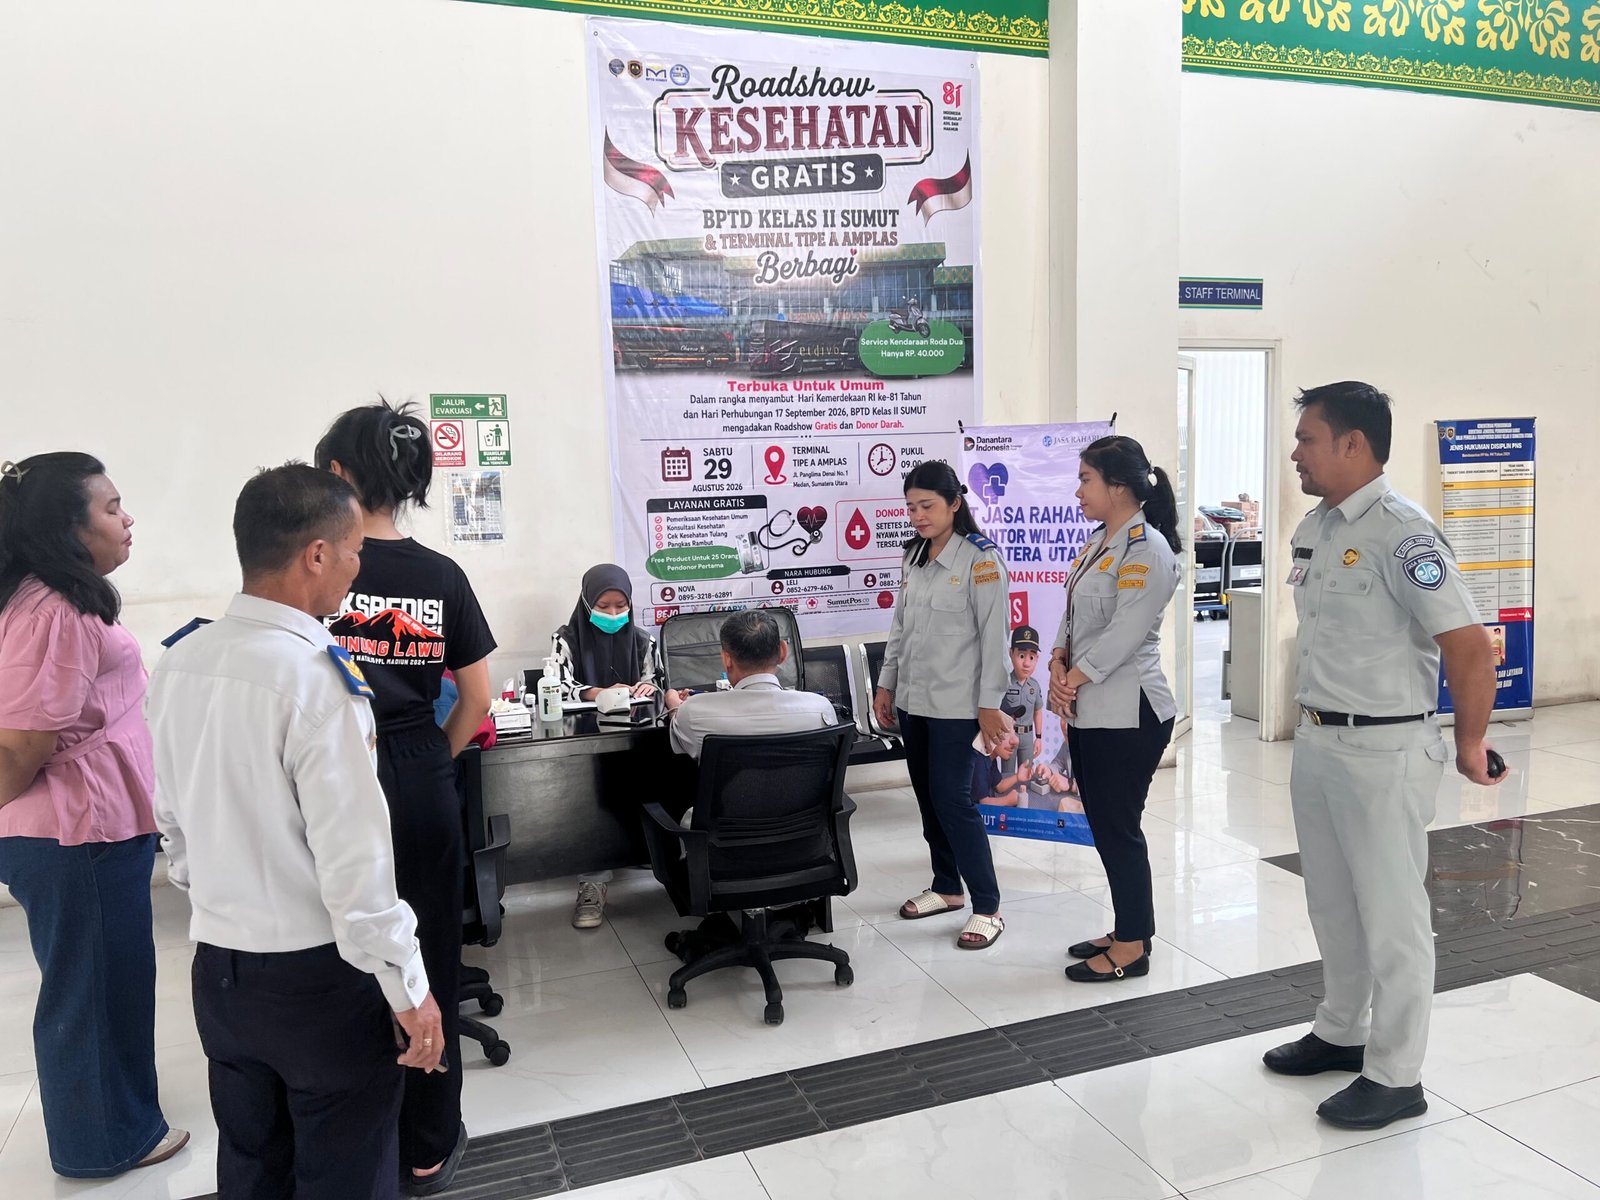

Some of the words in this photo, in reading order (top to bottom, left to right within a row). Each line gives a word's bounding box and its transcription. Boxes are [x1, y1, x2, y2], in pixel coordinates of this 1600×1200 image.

[711, 64, 875, 104] Roadshow
[943, 82, 963, 108] 81
[672, 104, 923, 168] KESEHATAN
[751, 162, 856, 190] GRATIS
[703, 210, 753, 229] BPTD
[758, 210, 817, 228] KELAS
[822, 210, 836, 228] II
[841, 209, 900, 228] SUMUT
[704, 234, 717, 251] &
[720, 232, 793, 249] TERMINAL
[794, 232, 826, 248] TIPE
[829, 232, 839, 247] A
[842, 231, 898, 246] AMPLAS
[755, 248, 858, 284] Berbagi
[1185, 287, 1214, 299] STAFF
[1216, 288, 1260, 300] TERMINAL
[860, 338, 888, 346] Service
[890, 338, 928, 346] Kendaraan
[881, 350, 904, 358] Hanya
[727, 381, 788, 392] Terbuka
[792, 380, 836, 391] Untuk
[840, 380, 884, 390] Umum
[690, 395, 716, 404] Dalam
[719, 395, 746, 406] rangka
[749, 394, 794, 405] menyambut
[798, 393, 814, 402] Hari
[816, 393, 866, 402] Kemerdekaan
[878, 392, 898, 400] ke-81
[900, 392, 922, 400] Tahun
[436, 407, 472, 415] EVAKUASI
[683, 410, 698, 418] dan
[702, 410, 718, 418] Hari
[722, 409, 773, 420] Perhubungan
[776, 409, 783, 418] 17
[786, 408, 826, 419] September
[828, 408, 848, 417] 2026,
[851, 408, 870, 416] BPTD
[872, 407, 892, 416] Kelas
[894, 406, 898, 415] II
[900, 406, 926, 414] SUMUT
[723, 424, 772, 434] mengadakan
[775, 422, 812, 431] Roadshow
[815, 422, 838, 430] Gratis
[840, 421, 854, 430] dan
[856, 420, 878, 429] Donor
[880, 420, 904, 428] Darah.
[703, 448, 732, 456] SABTU
[793, 446, 830, 454] TERMINAL
[900, 447, 924, 456] PUKUL
[704, 458, 732, 480] 29
[793, 458, 808, 468] TIPE
[810, 458, 816, 466] A
[818, 458, 848, 466] AMPLAS
[692, 484, 725, 492] AGUSTUS
[668, 500, 710, 510] LAYANAN
[714, 498, 745, 508] GRATIS
[876, 508, 904, 518] DONOR
[982, 506, 1025, 524] JASA
[980, 528, 1026, 544] ANTOR
[1036, 571, 1068, 582] KESE
[786, 584, 834, 594] 0852-6279-4676
[678, 592, 733, 600] 0895-3218-62891
[394, 642, 442, 658] LAWU
